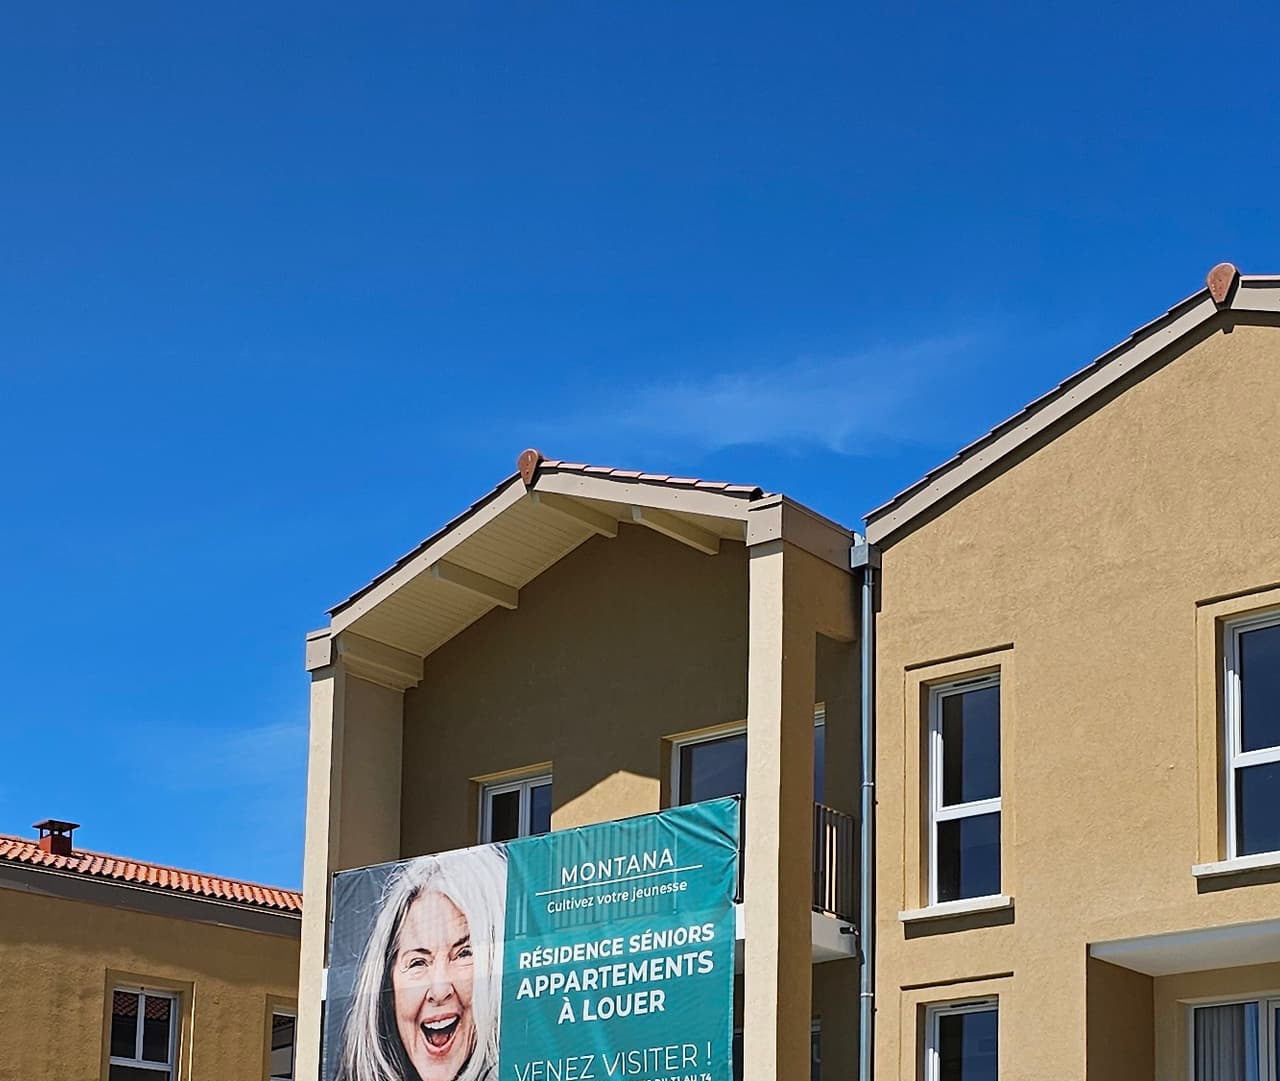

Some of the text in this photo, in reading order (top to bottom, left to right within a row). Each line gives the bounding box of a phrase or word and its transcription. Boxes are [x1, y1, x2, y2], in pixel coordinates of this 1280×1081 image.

[561, 848, 674, 886] MONTANA
[547, 881, 688, 913] Cultivez votre jeunesse
[519, 923, 715, 970] RÉSIDENCE SÉNIORS
[516, 951, 714, 1000] APPARTEMENTS
[558, 989, 666, 1025] À LOUER
[602, 1044, 698, 1077] VISITER
